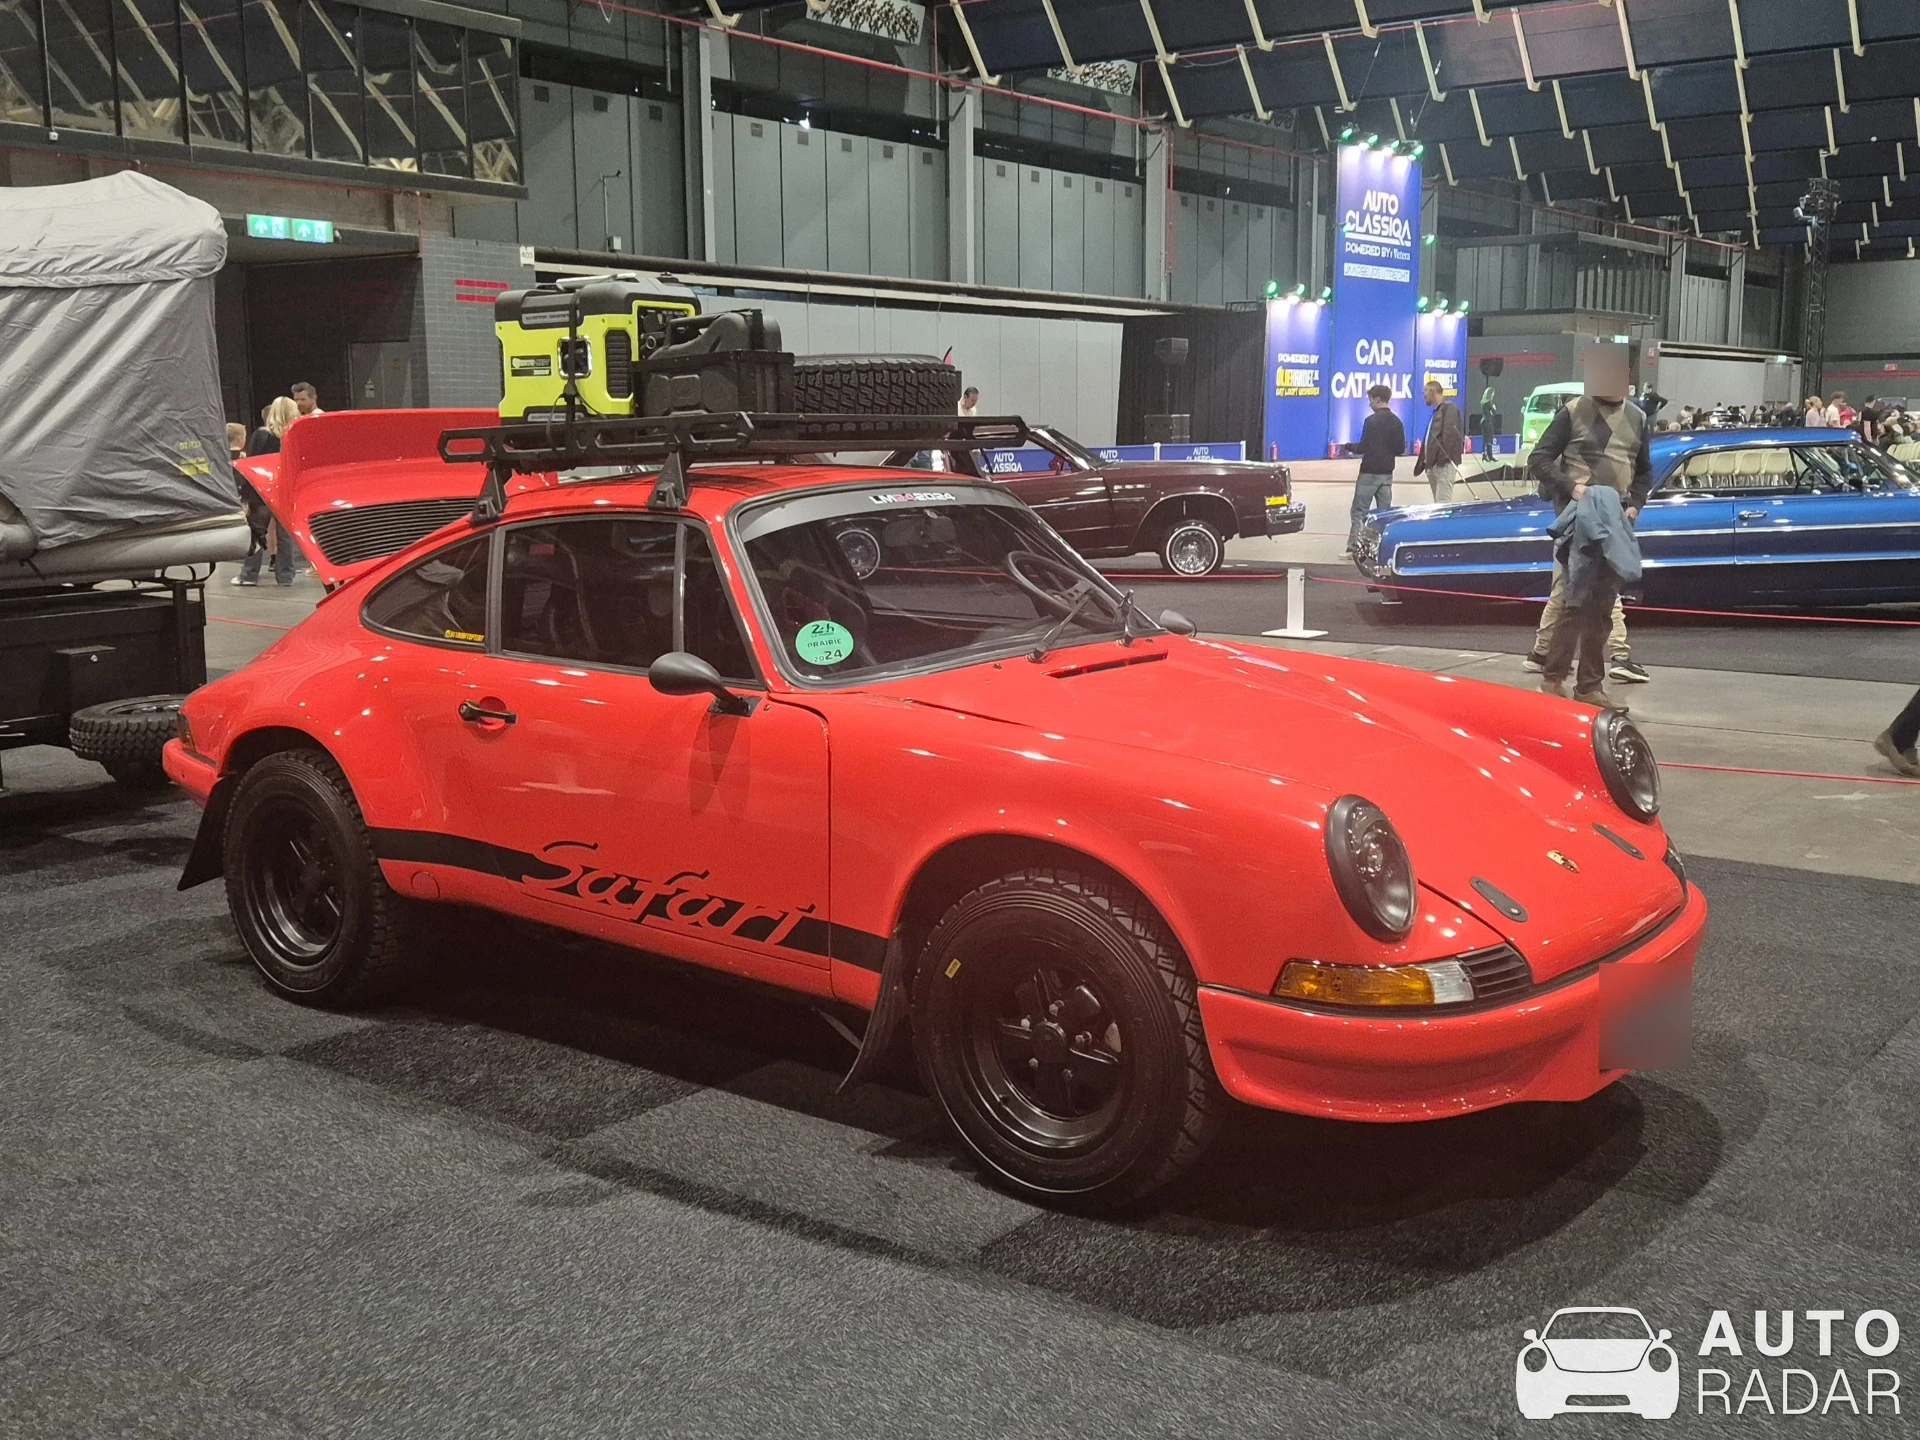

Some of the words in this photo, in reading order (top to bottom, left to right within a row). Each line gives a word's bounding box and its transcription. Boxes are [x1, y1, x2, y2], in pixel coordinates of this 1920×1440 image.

[1362, 189, 1399, 215] AUTO
[1344, 210, 1411, 244] CLASSIQA
[1345, 242, 1380, 256] POWERED
[1277, 353, 1309, 364] POWERED
[1356, 338, 1394, 366] CAR
[1331, 372, 1413, 399] CATWALK
[994, 452, 1015, 463] AUTO
[1100, 450, 1118, 459] AUTO
[1193, 446, 1209, 456] AUTO
[807, 639, 842, 648] PRAIRIE
[814, 649, 842, 662] 2024
[521, 840, 817, 946] Safari
